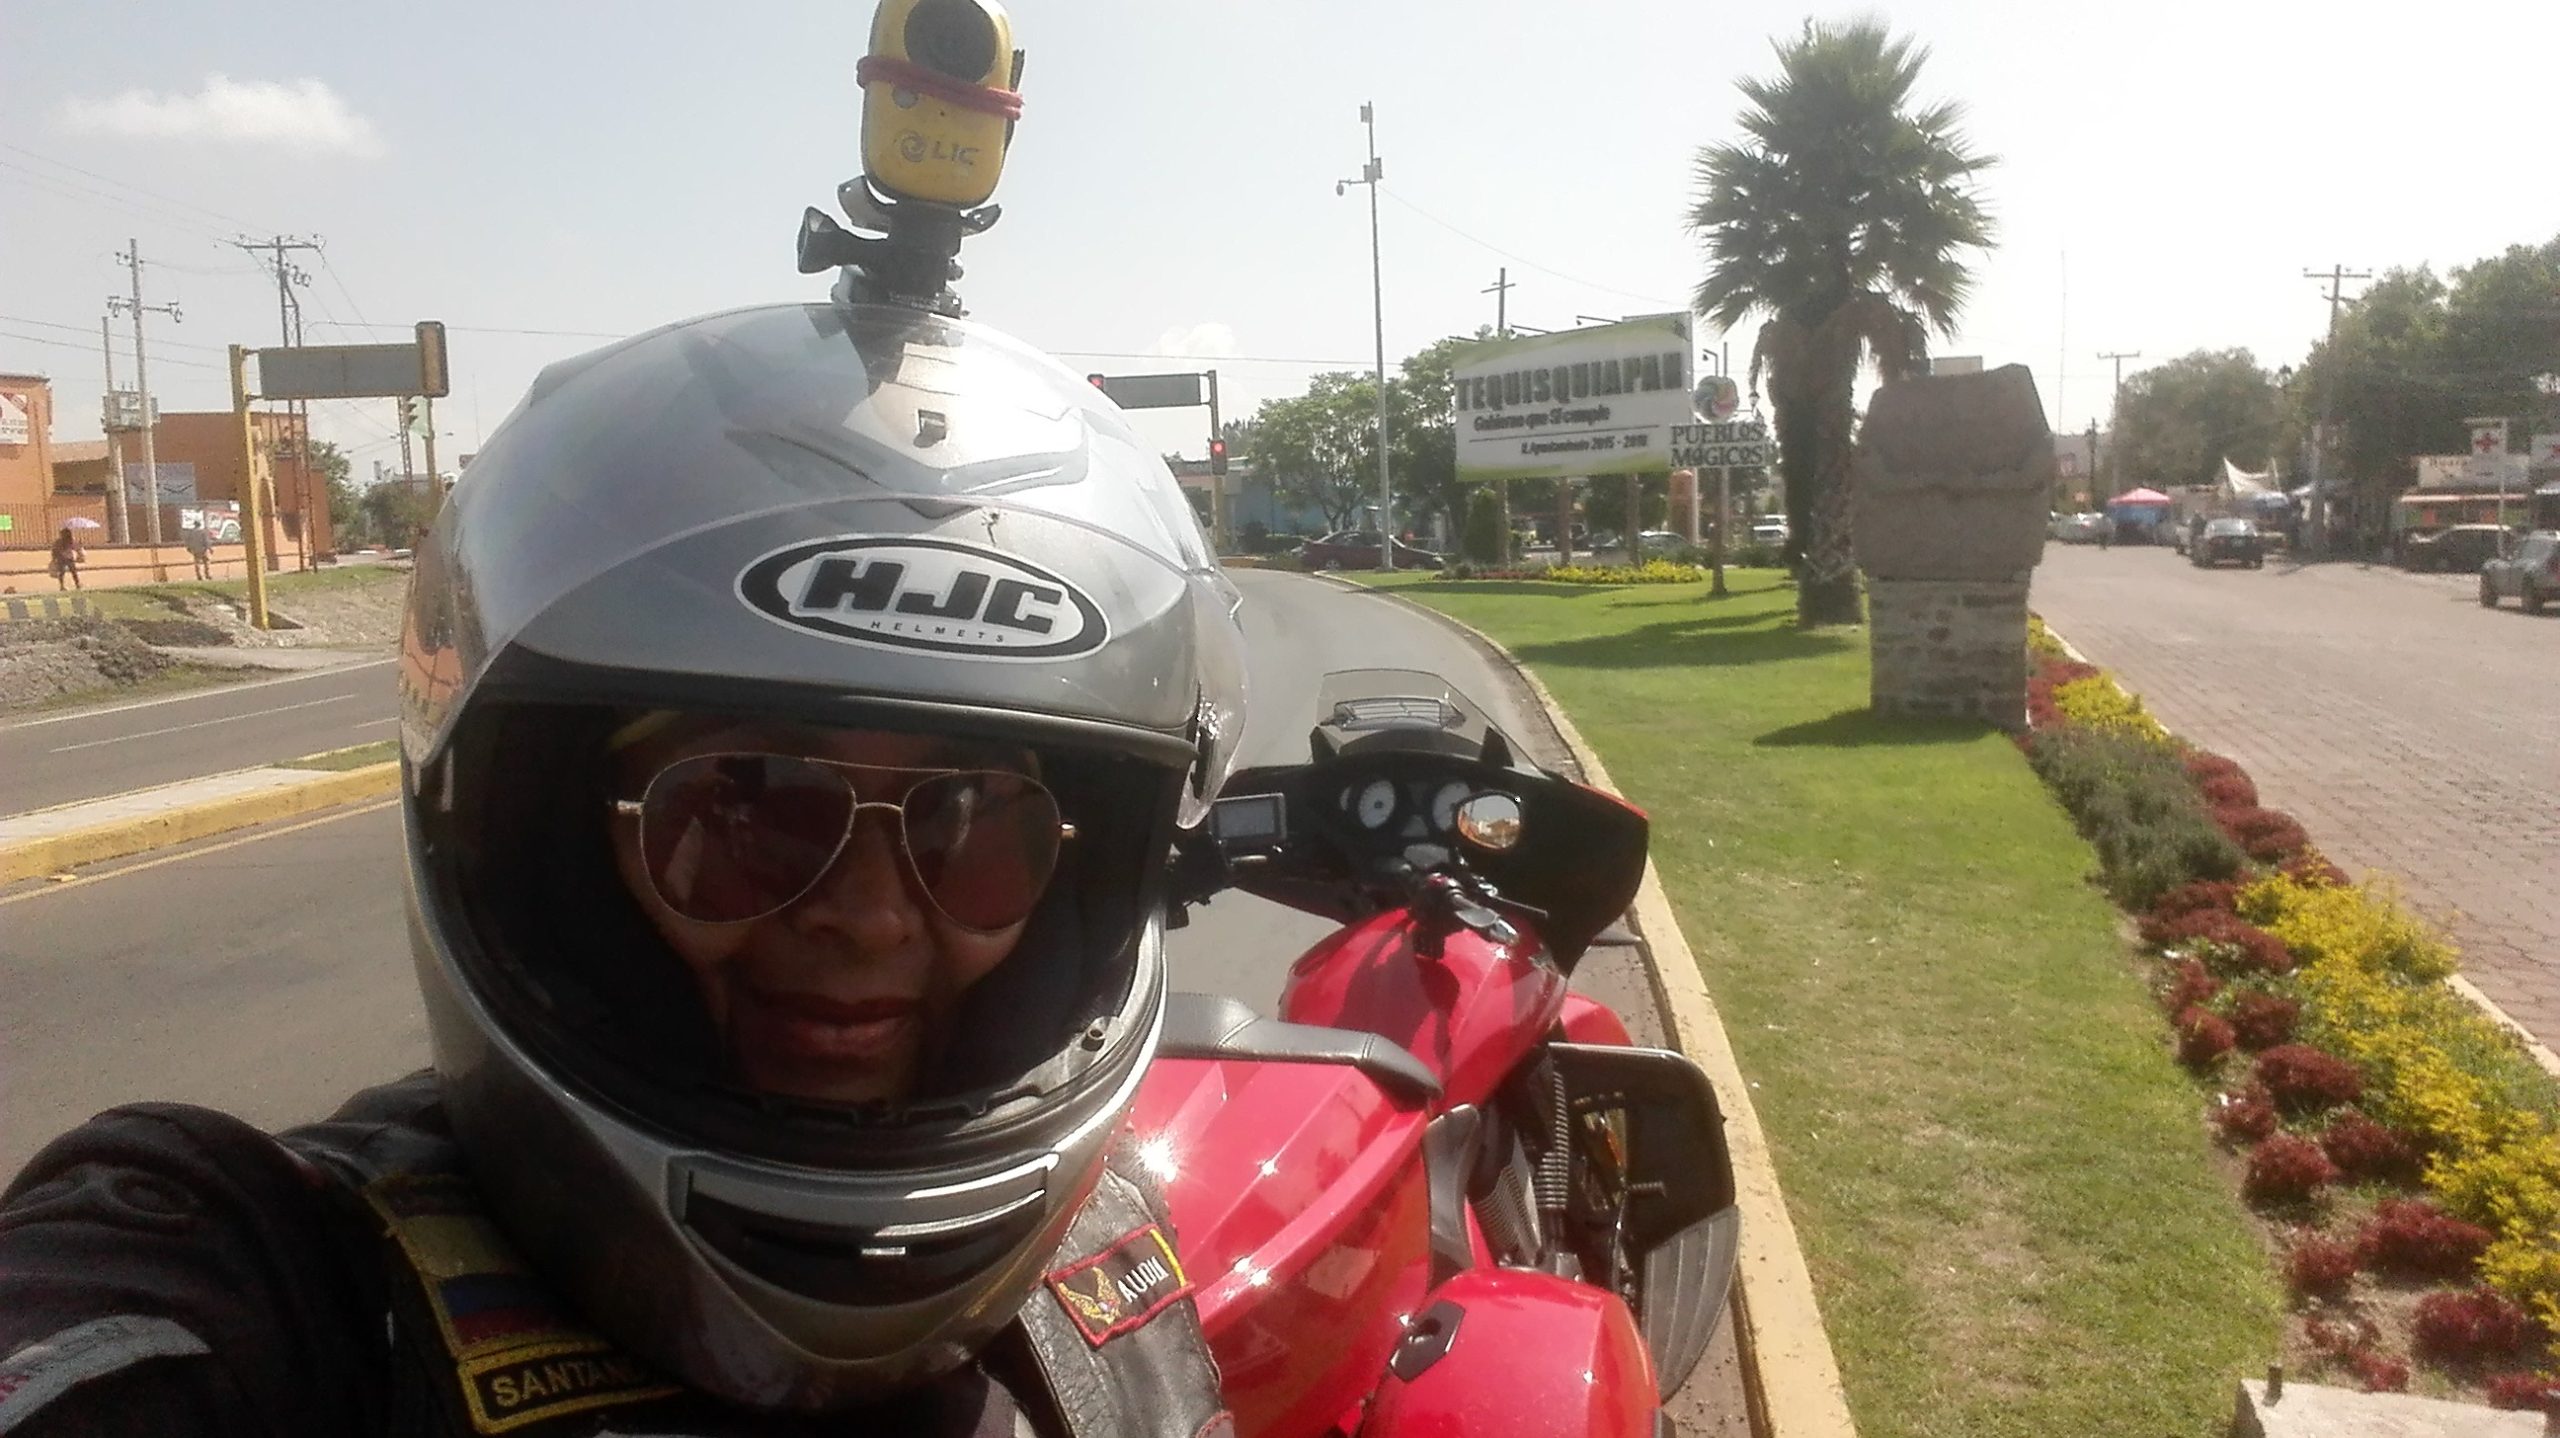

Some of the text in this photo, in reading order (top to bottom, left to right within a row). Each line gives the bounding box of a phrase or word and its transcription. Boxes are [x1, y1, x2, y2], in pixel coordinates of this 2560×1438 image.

[1454, 352, 1683, 412] TEQUISQUIAPAN
[1591, 435, 1616, 450] 2015
[1670, 422, 1767, 444] PUEBLOS
[801, 558, 1063, 635] HJC
[870, 620, 1005, 643] HELMETS
